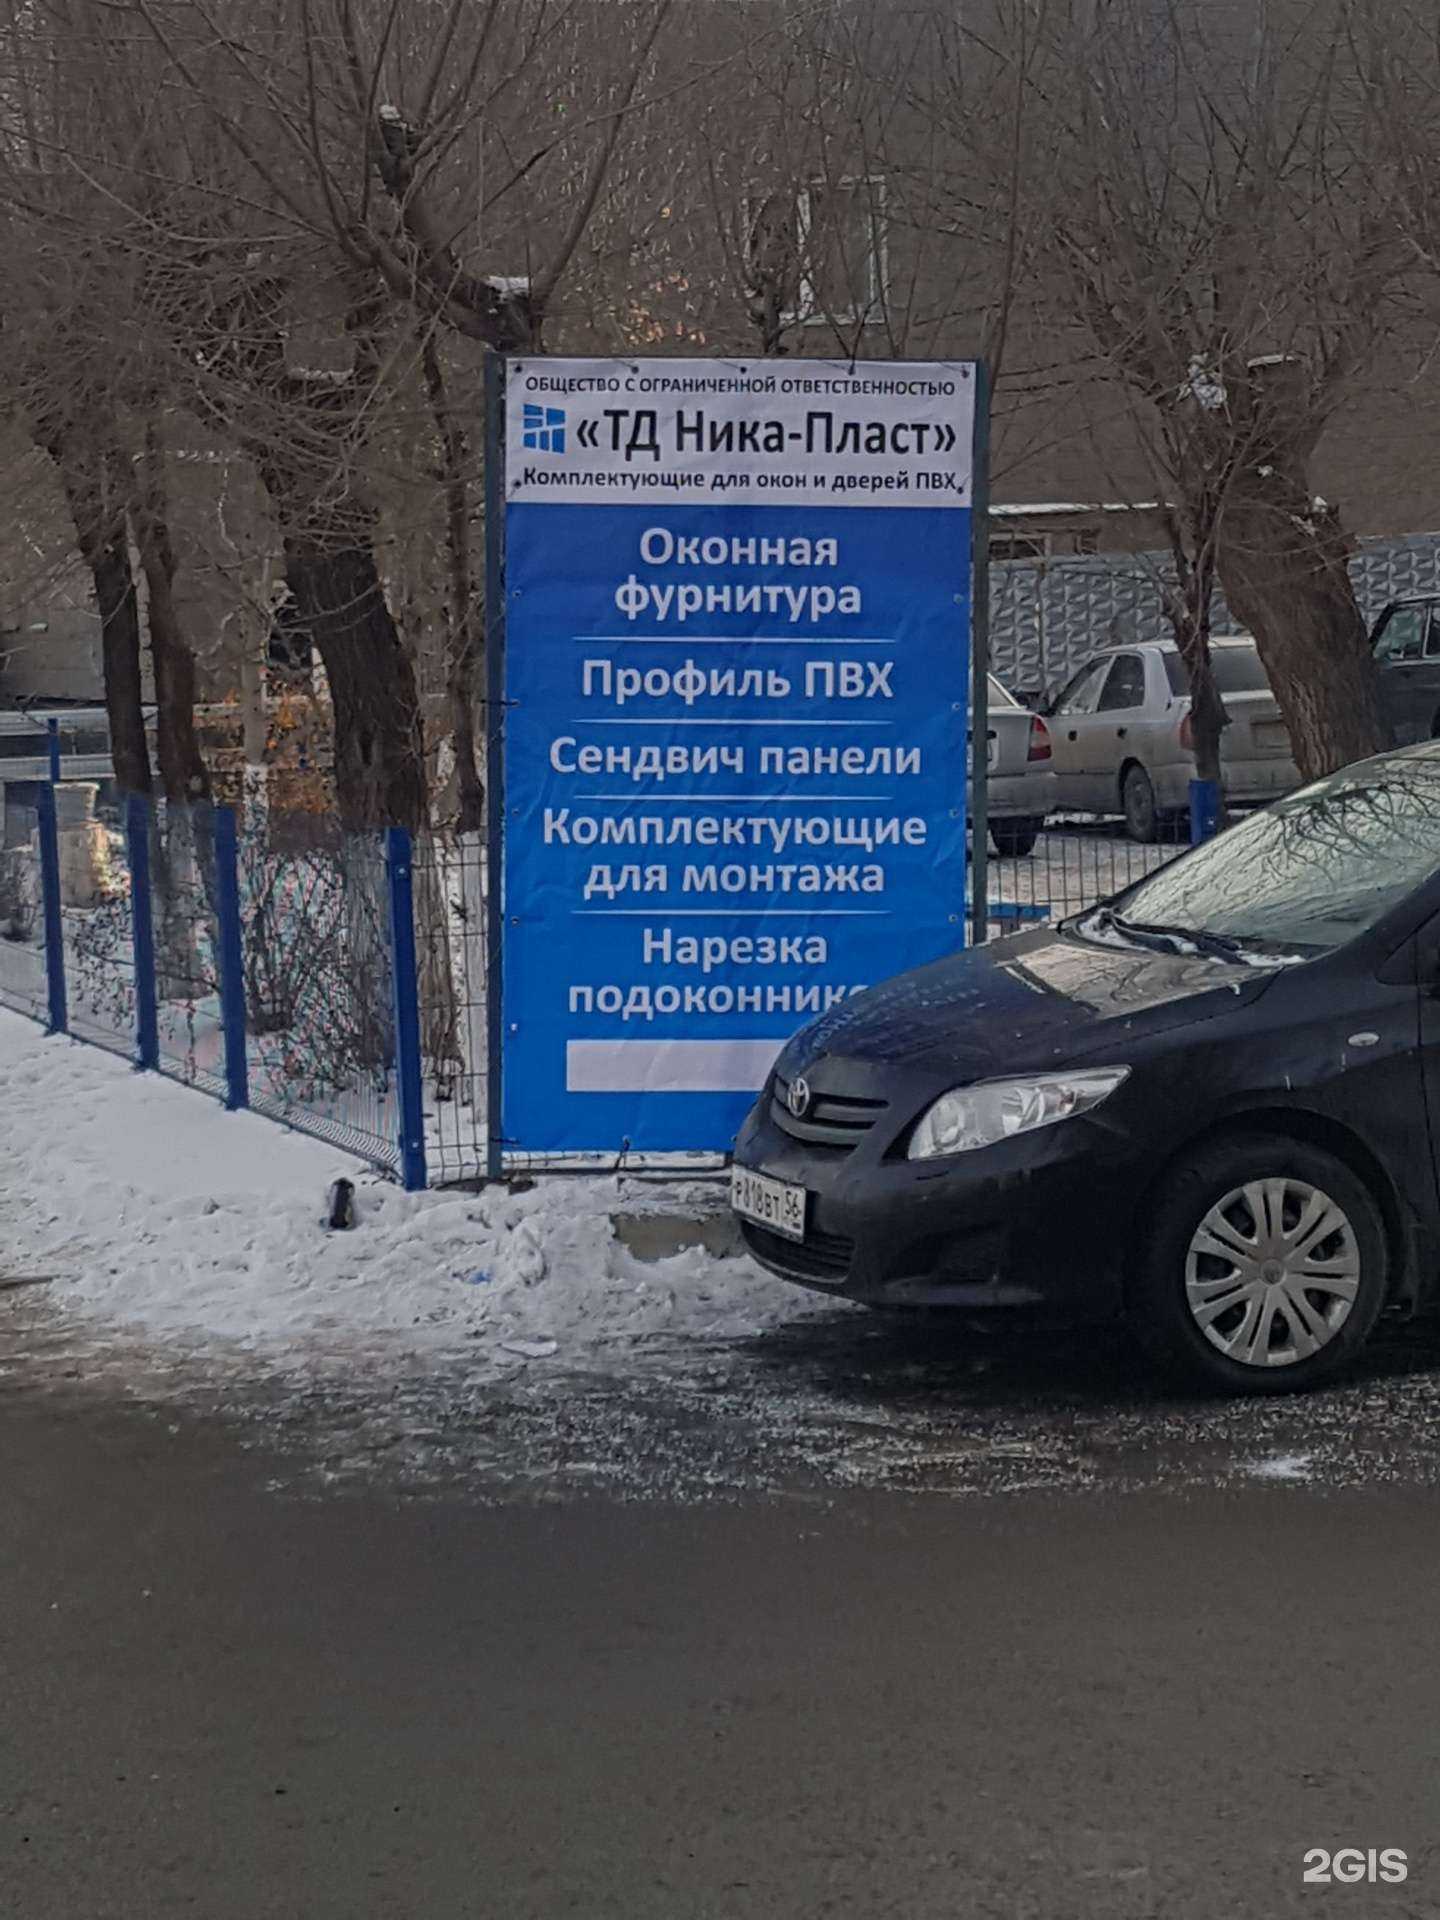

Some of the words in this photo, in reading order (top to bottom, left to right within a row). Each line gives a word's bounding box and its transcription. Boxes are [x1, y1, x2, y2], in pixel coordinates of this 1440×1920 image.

[525, 376, 620, 394] ОБЩЕСТВО
[625, 377, 635, 392] С
[639, 375, 776, 394] ОГРАНИЧЕННОЙ
[780, 378, 956, 396] ОТВЕТСТВЕННОСТЬЮ
[576, 409, 661, 462] «ТД
[675, 409, 957, 455] Ника-Пласт»
[523, 466, 705, 490] Комплектующие
[710, 474, 750, 491] для
[756, 474, 807, 489] окон
[813, 475, 826, 489] и
[831, 470, 909, 492] дверей
[916, 472, 956, 490] ПВХ
[640, 527, 838, 566] Оконная
[614, 574, 862, 622] фурнитура
[583, 659, 791, 705] Профиль
[804, 661, 894, 699] ПВХ
[550, 736, 743, 783] Сендвич
[760, 745, 921, 775] панели
[543, 808, 928, 854] Комплектующие
[583, 864, 667, 900] для
[682, 864, 885, 892] монтажа
[643, 928, 828, 973] Нарезка
[568, 985, 869, 1021] подоконник
